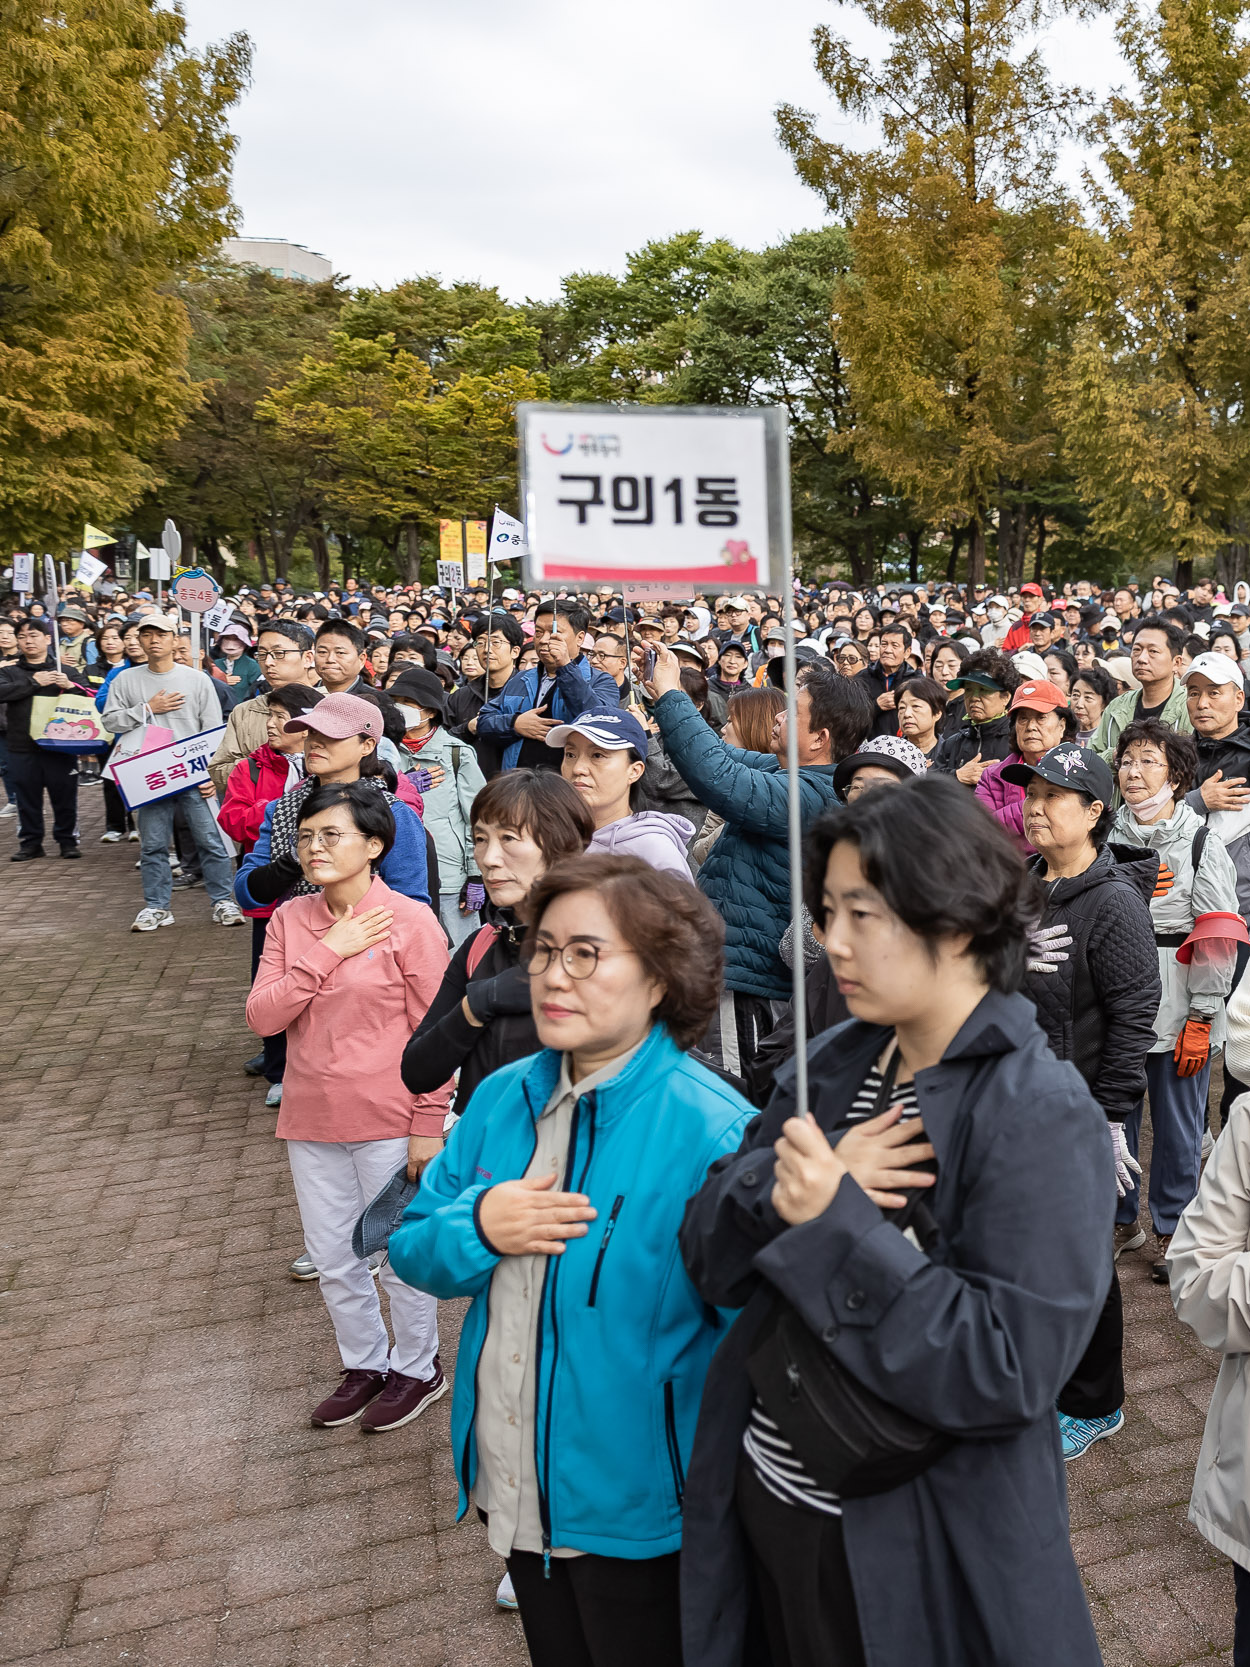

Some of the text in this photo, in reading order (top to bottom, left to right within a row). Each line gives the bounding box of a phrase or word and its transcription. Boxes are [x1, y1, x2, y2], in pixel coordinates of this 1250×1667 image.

[558, 475, 739, 526] 구의1동
[439, 564, 461, 586] 구의2동
[180, 588, 213, 603] 중곡4동
[1035, 611, 1044, 621] P
[144, 751, 216, 791] 중곡제
